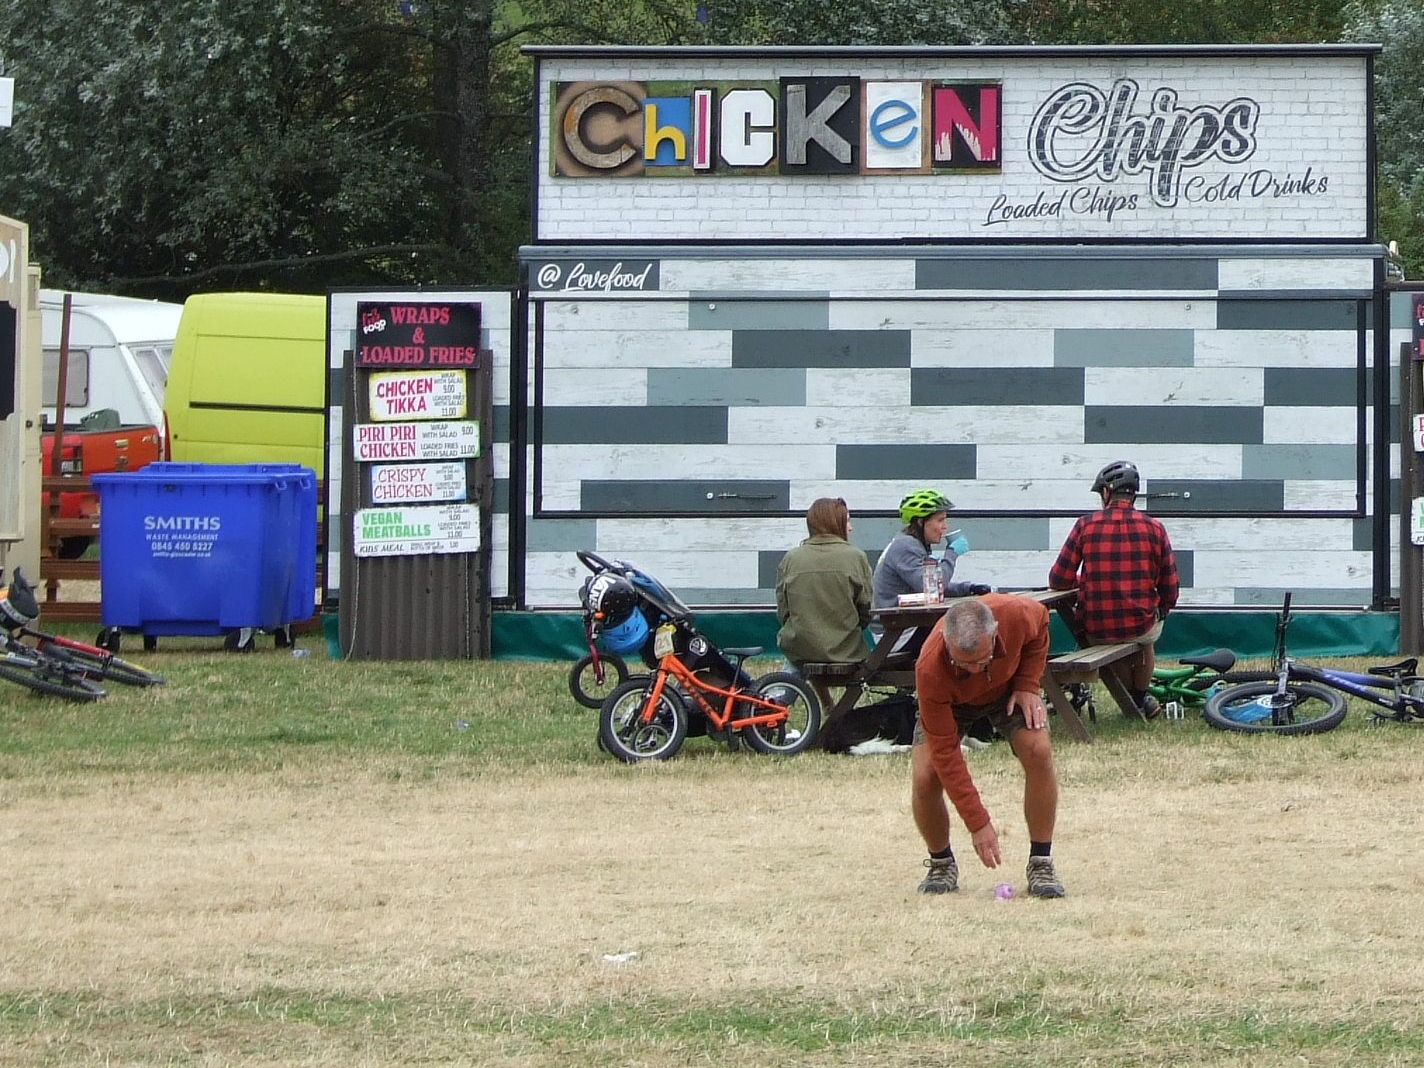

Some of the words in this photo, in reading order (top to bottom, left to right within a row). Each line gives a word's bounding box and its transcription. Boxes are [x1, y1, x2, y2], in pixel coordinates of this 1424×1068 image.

[1028, 78, 1260, 207] Chips
[1184, 171, 1244, 202] Cold
[1247, 167, 1328, 199] Drinks
[982, 190, 1069, 226] Loaded
[1070, 187, 1139, 223] Chips
[390, 307, 450, 324] WRAPS
[412, 327, 425, 344] &
[362, 346, 424, 364] LOADED
[429, 347, 475, 364] FRIES
[377, 378, 433, 398] CHICKEN
[386, 396, 427, 414] TIKKA
[359, 426, 385, 442] PIRI
[390, 425, 416, 441] PIRI
[462, 426, 473, 435] 9.00
[360, 442, 416, 458] CHICKEN
[460, 445, 475, 454] 11.00
[378, 468, 426, 483] CRISPY
[373, 484, 433, 499] CHICKEN
[144, 516, 221, 530] SMITHS
[362, 512, 402, 525] VEGAN
[362, 524, 431, 539] MEATBALLS
[151, 542, 172, 551] 0845
[174, 542, 191, 551] 450
[192, 542, 213, 551] 5227
[360, 544, 378, 553] KIDS
[381, 543, 404, 552] MEAL
